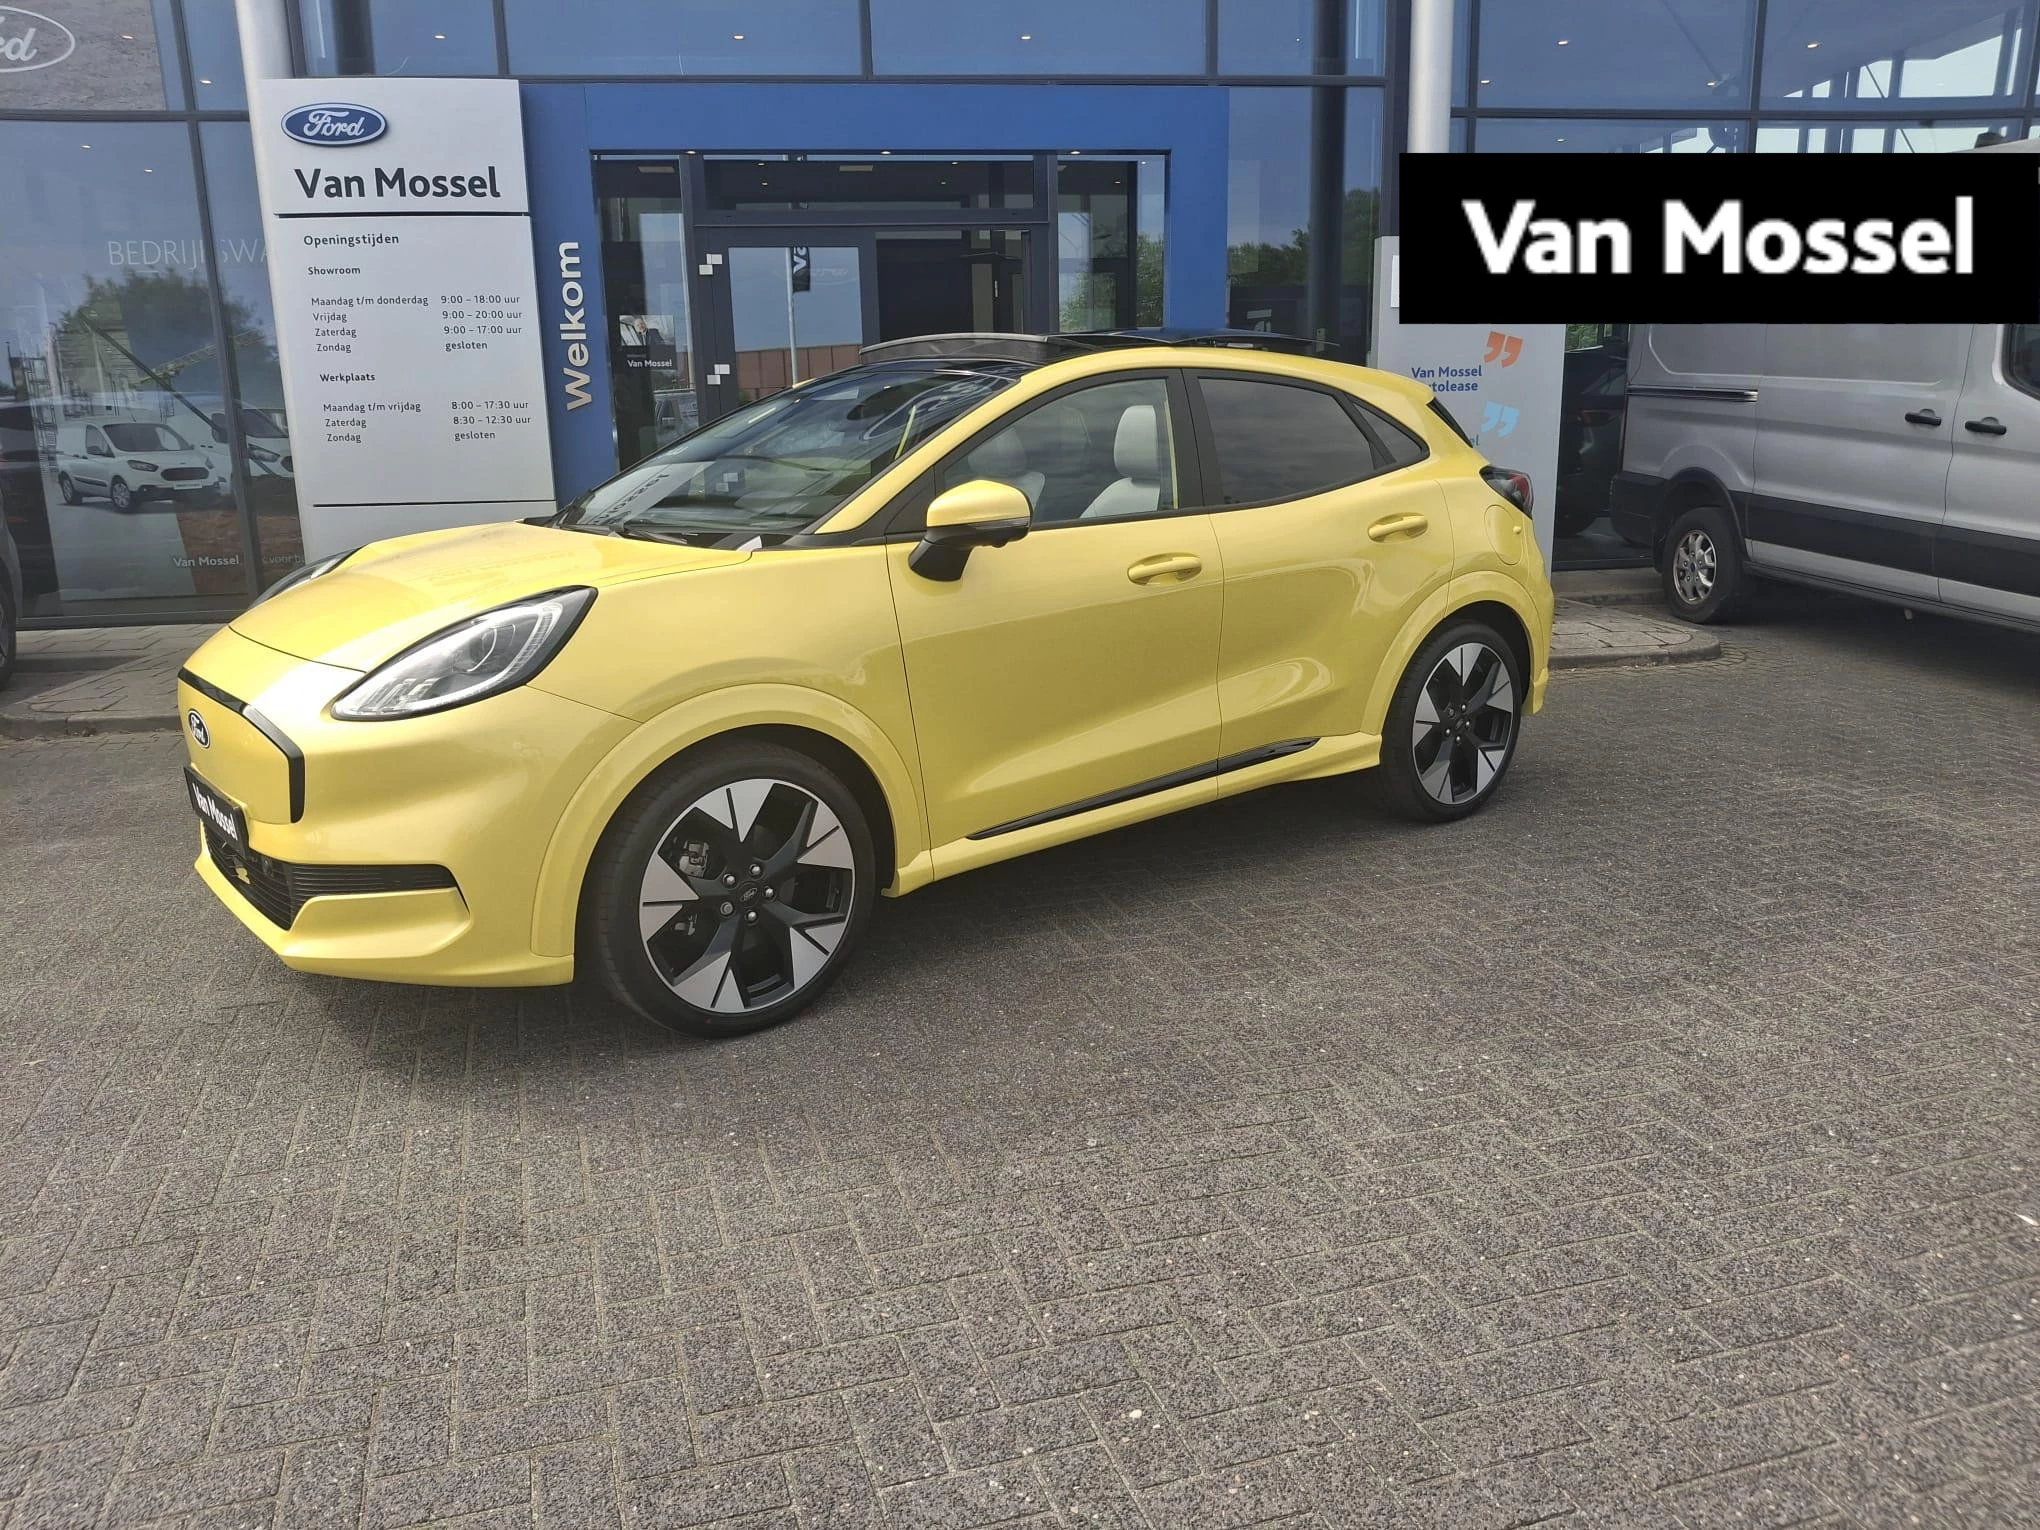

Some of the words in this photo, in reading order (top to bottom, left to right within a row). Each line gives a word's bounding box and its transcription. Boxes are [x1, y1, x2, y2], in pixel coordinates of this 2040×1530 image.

[303, 109, 366, 137] Ford
[294, 168, 366, 199] Van
[374, 165, 501, 198] Mossel
[303, 233, 400, 249] Openingstijden
[307, 266, 361, 276] Showroom
[311, 296, 354, 308] Maandag
[356, 295, 375, 305] t/m
[376, 295, 429, 307] donderdag
[440, 295, 463, 304] 9:00
[473, 294, 502, 304] 18:00
[504, 296, 521, 304] uur
[312, 312, 348, 324] Vrijdag
[442, 310, 465, 320] 9:00
[475, 310, 504, 319] 20:00
[506, 311, 523, 319] uur
[314, 327, 357, 339] Zaterdag
[443, 325, 466, 335] 9:00
[477, 325, 504, 334] 17:00
[559, 241, 593, 410] Welkom
[316, 342, 352, 354] Zondag
[445, 340, 488, 353] gesloten
[627, 359, 643, 368] Van
[644, 358, 673, 367] Mossel
[319, 372, 376, 384] Werkplaats
[1411, 367, 1435, 379] Van
[1438, 364, 1483, 378] Mossel
[1428, 379, 1479, 392] tolease
[323, 402, 366, 414] Maandag
[367, 402, 386, 412] t/m
[387, 401, 422, 413] vrijdag
[451, 401, 474, 410] 8:00
[484, 400, 511, 410] 17:30
[324, 417, 367, 429] Zaterdag
[452, 415, 475, 425] 8:30
[485, 415, 513, 424] 12:30
[326, 432, 362, 444] Zondag
[454, 430, 496, 442] gesloten
[173, 557, 196, 568] Van
[198, 554, 240, 567] Mossel
[192, 782, 211, 817] Van
[206, 795, 238, 841] Mossel
